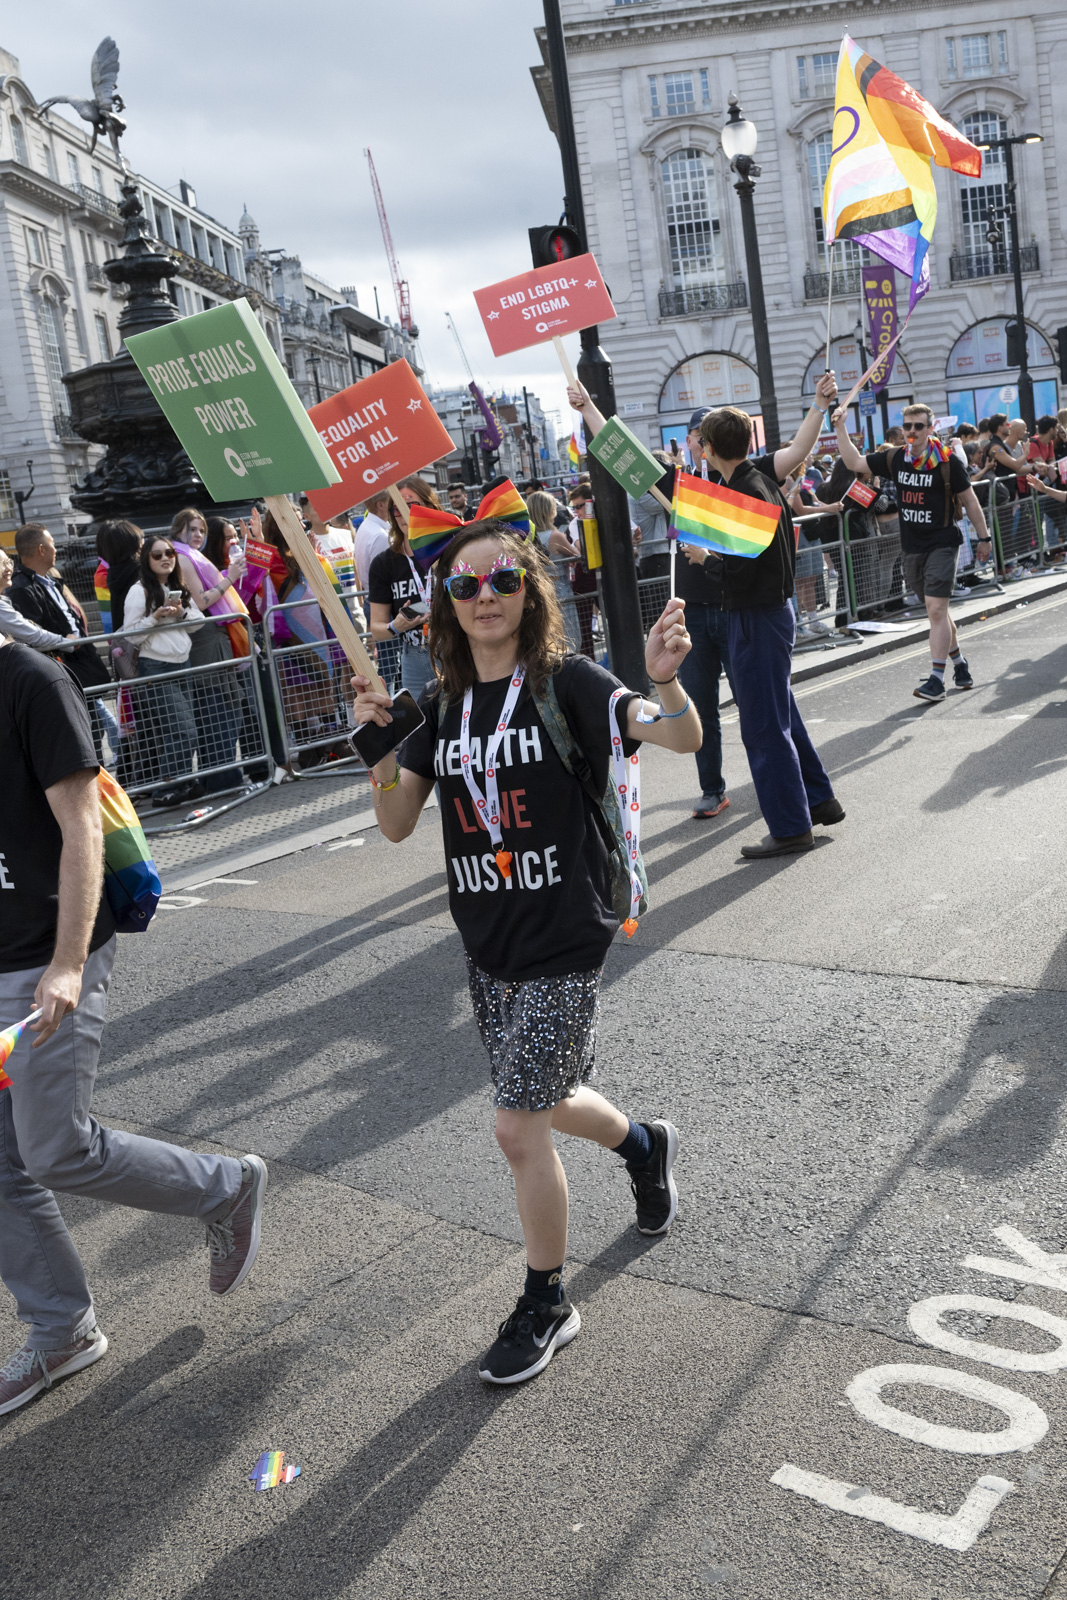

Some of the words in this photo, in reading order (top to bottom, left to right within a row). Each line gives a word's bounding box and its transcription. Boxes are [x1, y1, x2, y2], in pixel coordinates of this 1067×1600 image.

[499, 291, 526, 309] END
[528, 277, 579, 299] LGBTQ+
[521, 296, 570, 320] STIGMA
[147, 357, 199, 395] PRIDE
[188, 339, 257, 385] EQUALS
[194, 397, 257, 436] POWER
[318, 398, 387, 448] EQUALITY
[336, 441, 370, 469] FOR
[369, 426, 399, 452] ALL
[597, 441, 616, 462] WE'RE
[607, 430, 625, 449] STILL
[612, 447, 638, 476] STANDING!
[897, 471, 933, 487] HEALTH
[901, 490, 924, 504] LOVE
[901, 508, 932, 523] STICE
